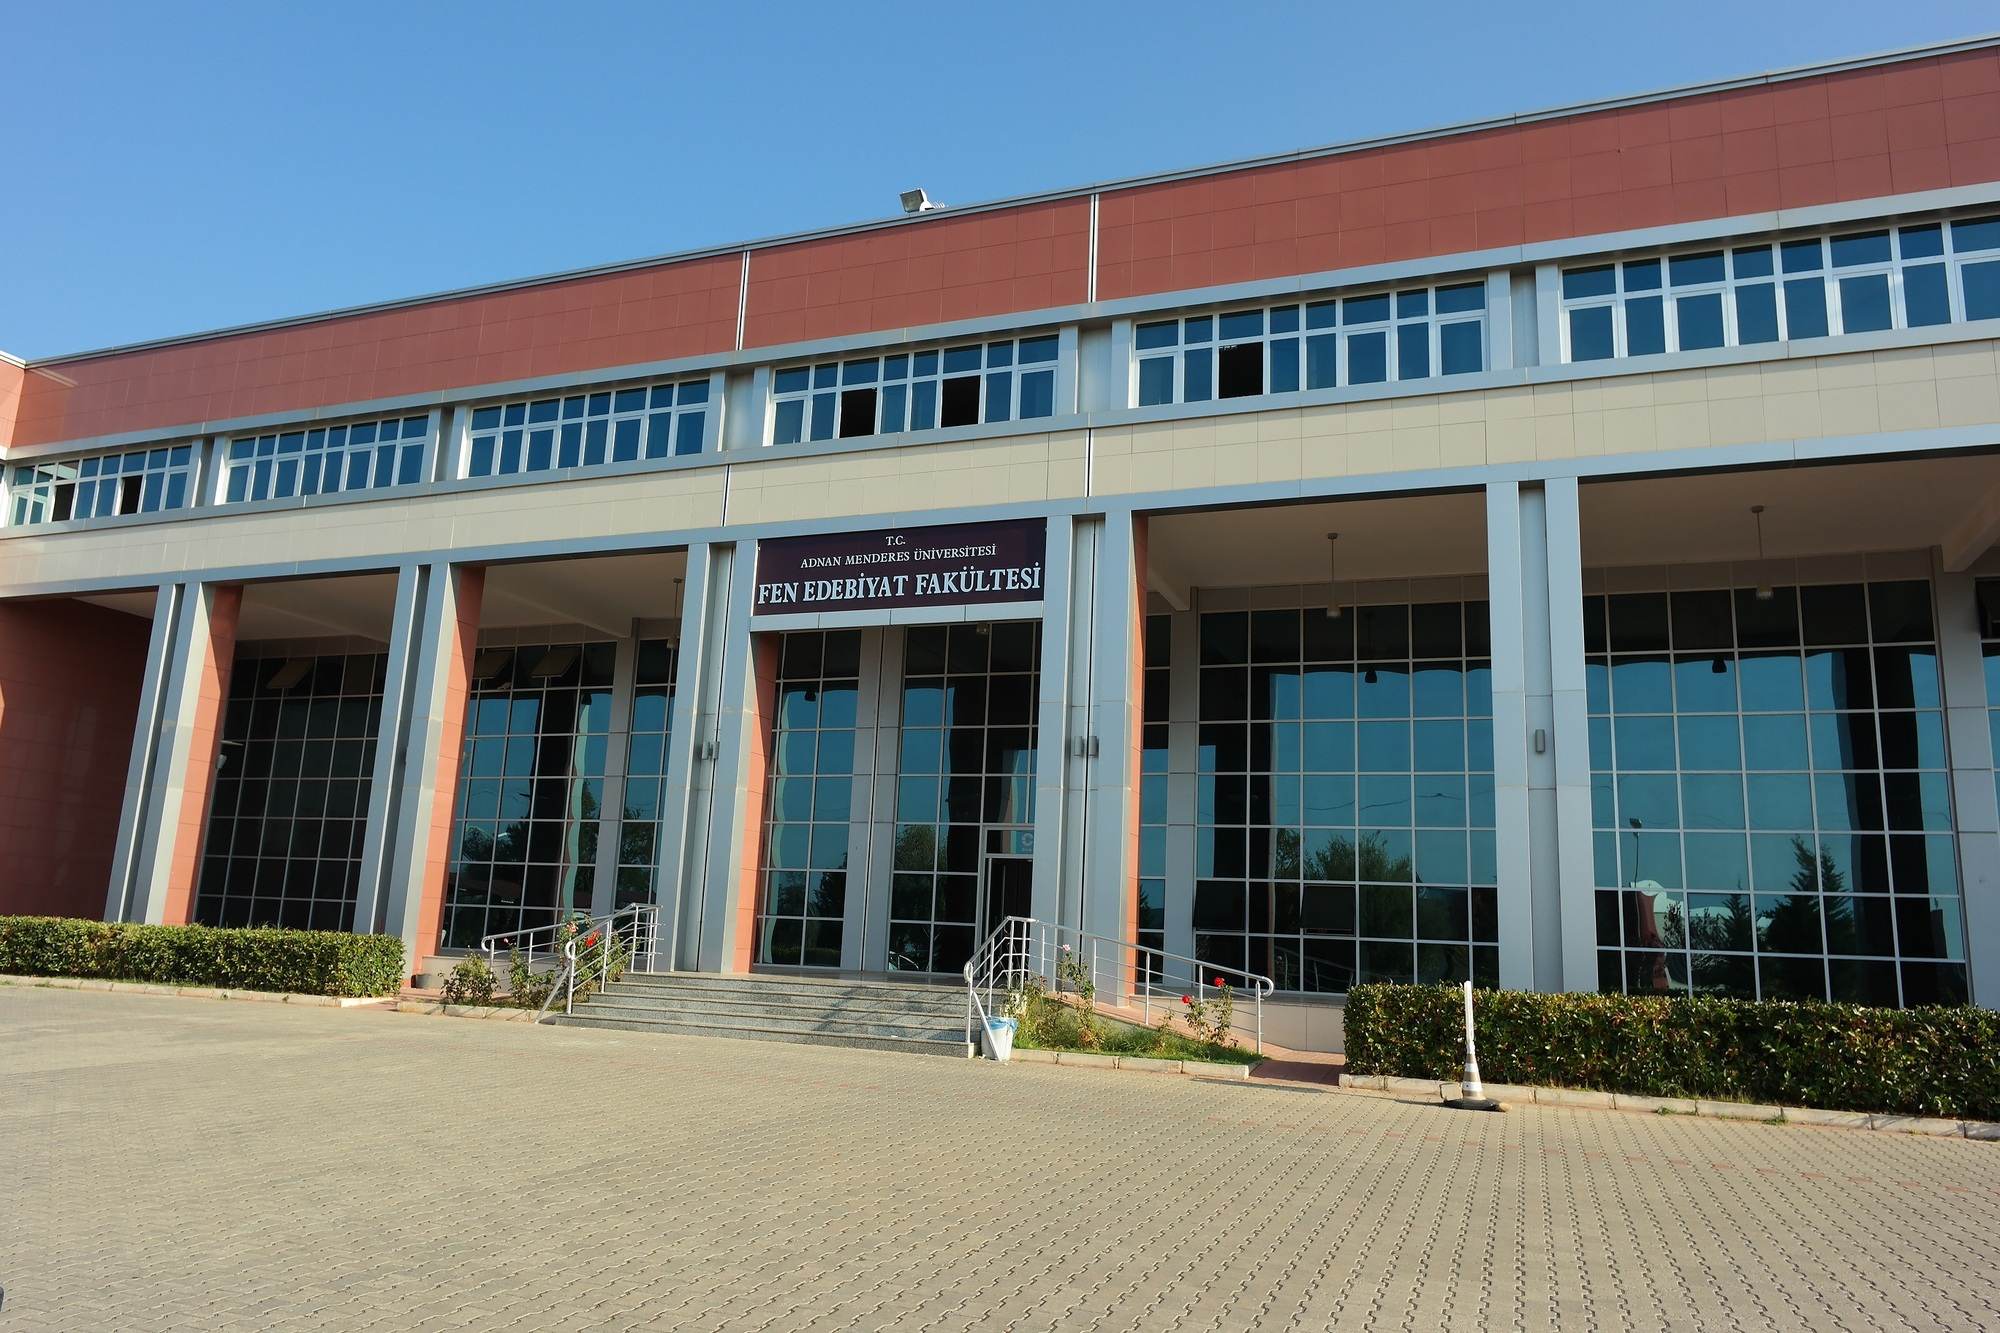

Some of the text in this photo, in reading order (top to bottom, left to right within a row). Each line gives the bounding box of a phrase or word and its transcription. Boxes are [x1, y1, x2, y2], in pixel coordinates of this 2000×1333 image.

[885, 535, 906, 546] T.C.
[800, 543, 997, 569] ADNAN MENDERES ÜNİVERSİTESİ
[757, 561, 1041, 605] FEN EDEBİYAT FAKÜLTESİ
